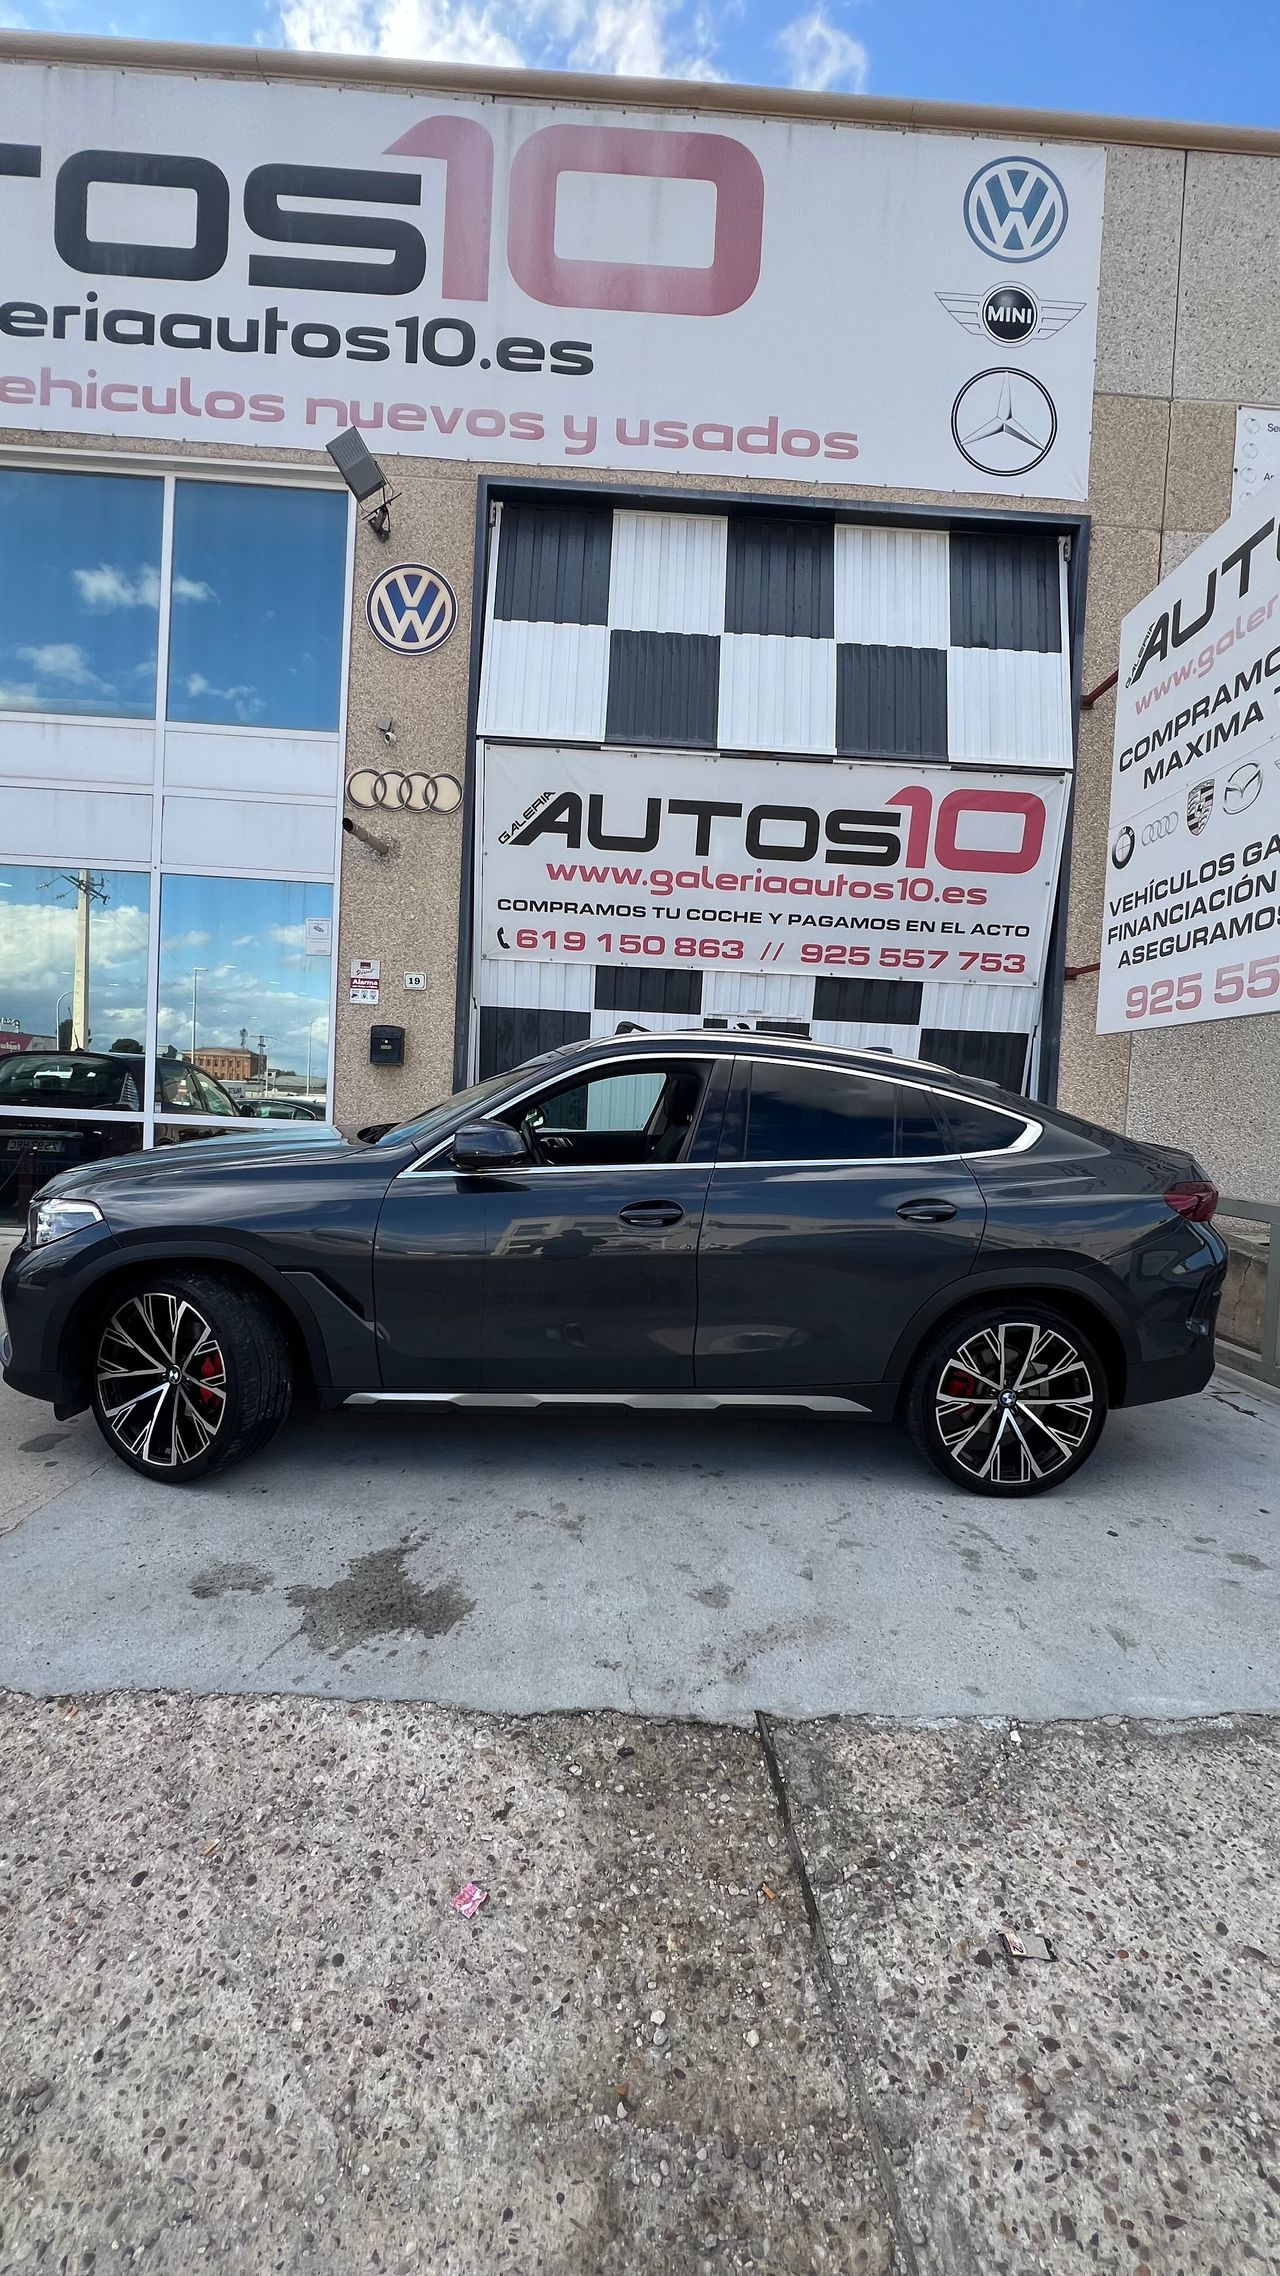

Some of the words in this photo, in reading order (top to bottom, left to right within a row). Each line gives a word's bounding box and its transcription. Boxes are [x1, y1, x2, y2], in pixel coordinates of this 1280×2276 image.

[987, 305, 1032, 324] MINI
[306, 397, 544, 441] nuevos
[563, 415, 597, 455] y
[616, 416, 859, 460] usados
[1131, 517, 1280, 686] AUT
[1143, 700, 1265, 789] MAXIMA
[498, 791, 556, 845] GALERIA
[509, 785, 1047, 875] AUTOS10
[546, 863, 988, 906] www.galeriaautos10.es
[1107, 870, 1277, 946] FINANCIACIÓN
[1109, 852, 1235, 917] VEHÍCULOS
[497, 899, 647, 918] COMPRAMOS
[652, 906, 681, 920] TU
[686, 908, 763, 924] COCHE
[768, 912, 783, 925] Y
[787, 913, 900, 931] PAGAMOS
[906, 919, 936, 933] EN
[940, 921, 966, 935] EL
[970, 923, 1031, 938] ACTO
[1117, 904, 1280, 969] ASEGURAMO
[516, 928, 586, 952] 619
[597, 933, 666, 956] 150
[674, 936, 744, 960] 863
[800, 943, 871, 966] 925
[879, 947, 949, 970] 557
[958, 951, 1026, 974] 753
[352, 978, 378, 986] Alarma
[408, 977, 421, 985] 19
[1125, 972, 1203, 1019] 925
